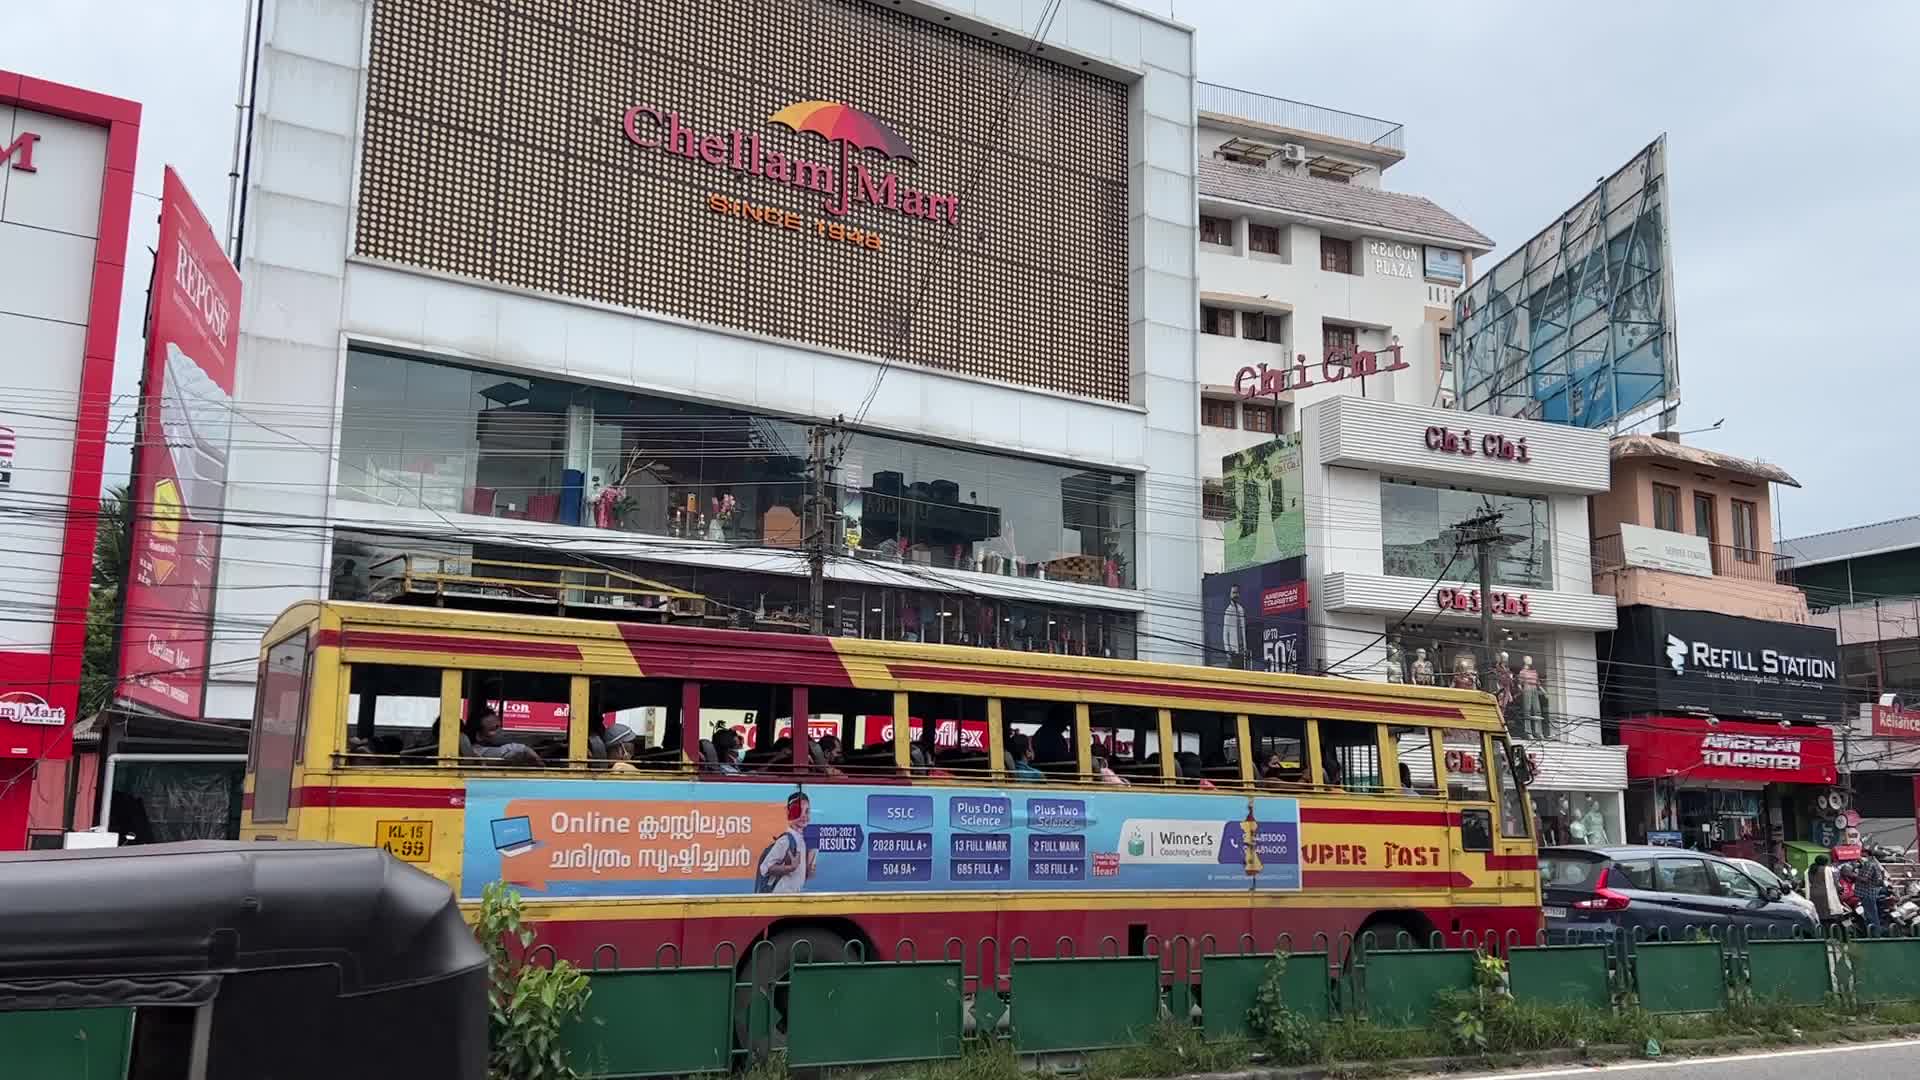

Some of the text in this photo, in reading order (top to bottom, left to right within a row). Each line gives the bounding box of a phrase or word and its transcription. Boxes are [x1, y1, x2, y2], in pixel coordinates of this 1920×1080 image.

[624, 105, 959, 225] Chellam Mart
[710, 191, 881, 250] SINCE 1948
[1375, 260, 1413, 278] PLAZA
[176, 240, 230, 348] REPOSE
[1234, 335, 1410, 400] Chi Chi
[1425, 426, 1532, 463] Chi Chi
[1437, 588, 1531, 617] Chi Chi
[1692, 642, 1836, 679] REFILL STATION
[23, 705, 64, 719] Mart
[1879, 709, 1920, 732] Reliance
[1700, 749, 1801, 770] TOURISTER
[887, 807, 914, 818] SSLC
[957, 803, 1005, 814] Plus One
[1034, 804, 1079, 816] Plus Two
[551, 811, 631, 834] Online
[960, 815, 1001, 826] Science
[1038, 816, 1076, 828] Science
[819, 826, 857, 837] 2020-2021
[819, 838, 857, 850] RESULTS
[872, 840, 928, 851] 2028 FULL A+
[955, 840, 1008, 852] 13 FULL MARK
[1159, 832, 1213, 846] Winner's
[1033, 841, 1080, 852] 2 FULL MARK
[1159, 847, 1213, 858] Coaching Centre
[550, 843, 632, 874] ചരിത്രം
[1301, 841, 1440, 869] UPER FAST
[883, 863, 899, 875] 504
[974, 864, 993, 875] FULL
[993, 864, 1004, 875] A+
[1034, 864, 1079, 875] 358 FULL A+
